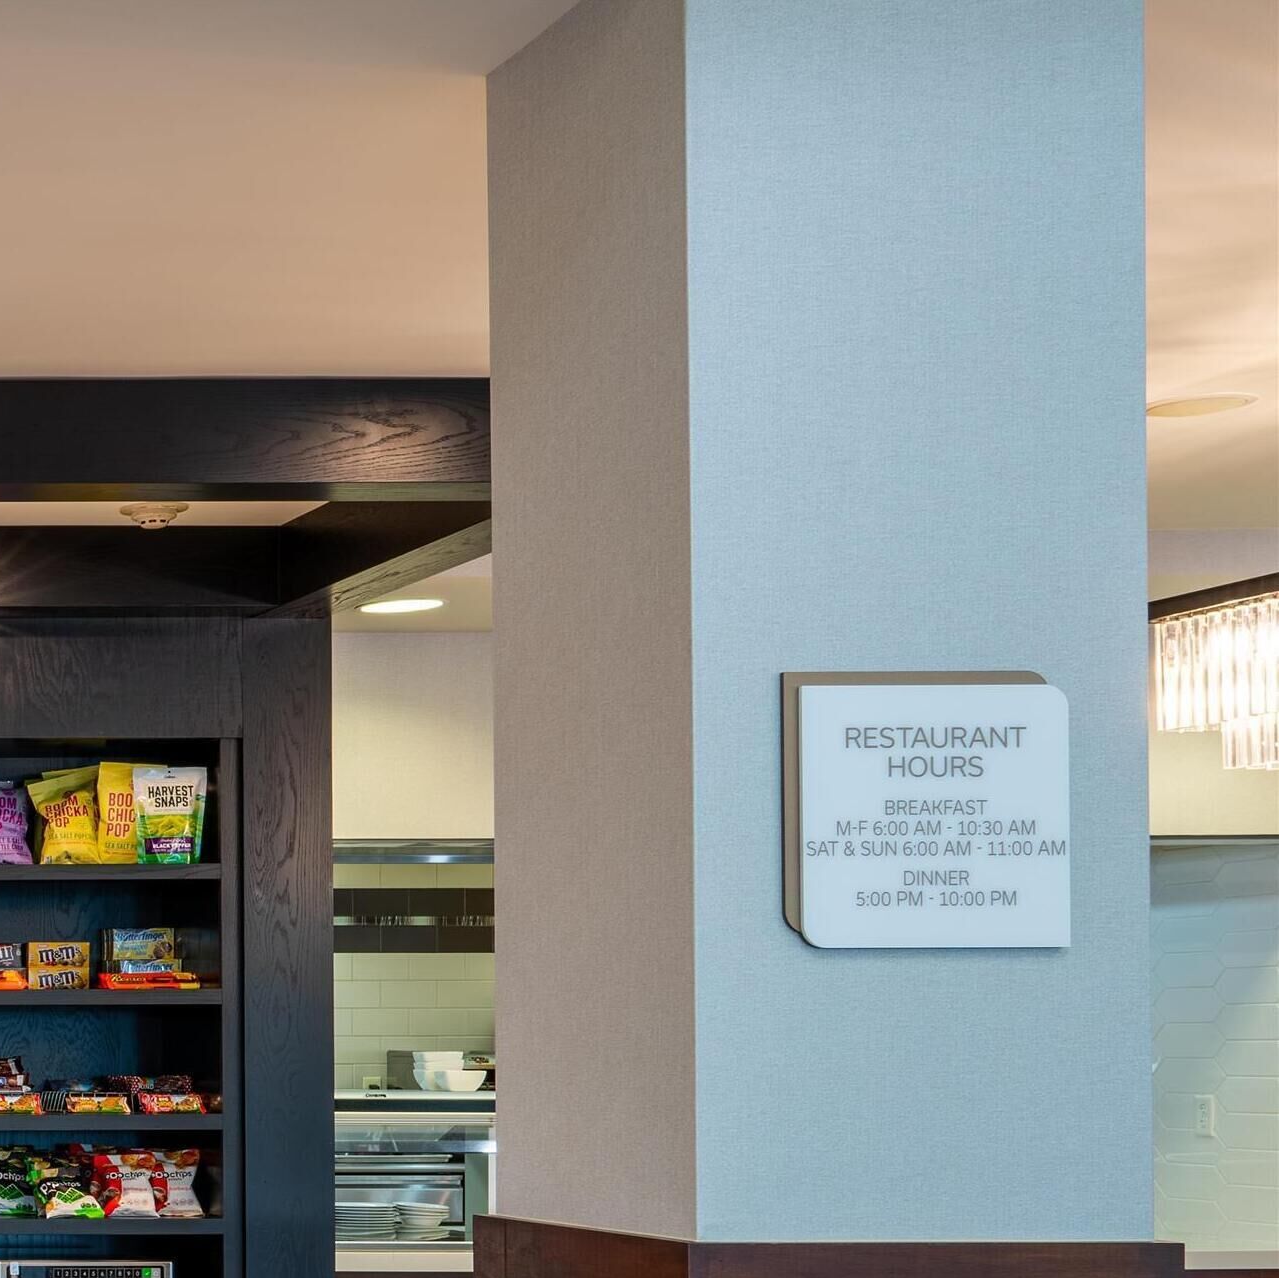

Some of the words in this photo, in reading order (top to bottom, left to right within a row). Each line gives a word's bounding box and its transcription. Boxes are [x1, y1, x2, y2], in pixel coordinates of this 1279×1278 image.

[845, 726, 1027, 749] RESTAURANT
[887, 756, 985, 778] HOURS
[108, 793, 134, 806] BOO
[148, 785, 194, 799] HARVEST
[154, 797, 189, 808] SNAPS
[884, 799, 988, 816] BREAKFAST
[107, 809, 136, 822] CHIC
[106, 823, 130, 837] POP
[835, 821, 868, 836] M-F
[873, 821, 909, 836] 6:00
[914, 821, 942, 836] AM
[958, 821, 1003, 836] 10:30
[1008, 821, 1036, 836] AM
[806, 841, 839, 856] SAT
[843, 841, 857, 856] &
[860, 841, 898, 856] SUN
[902, 841, 939, 856] 6:00
[943, 841, 972, 856] AM
[988, 841, 1033, 856] 11:00
[1038, 841, 1066, 856] AM
[903, 870, 970, 886] DINNER
[856, 891, 891, 907] 5:00
[897, 891, 923, 907] PM
[940, 891, 985, 907] 10:00
[990, 891, 1018, 907] PM
